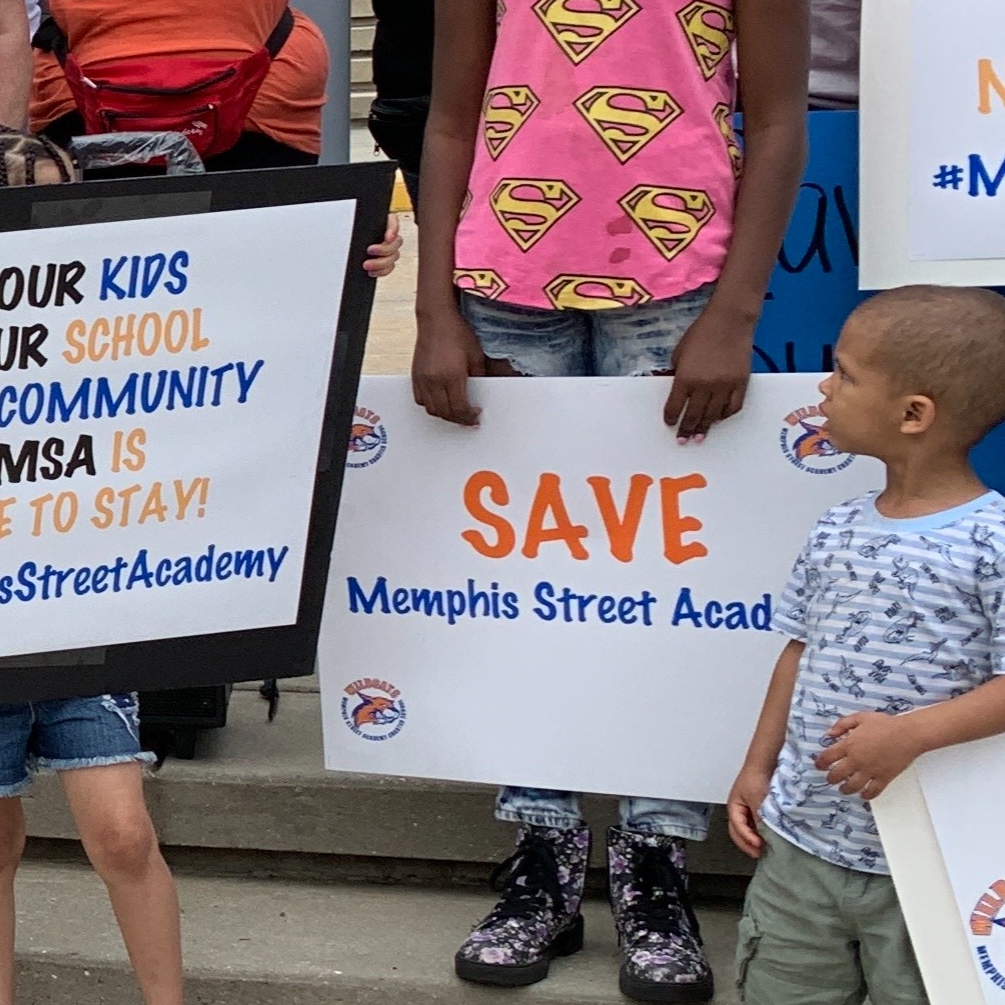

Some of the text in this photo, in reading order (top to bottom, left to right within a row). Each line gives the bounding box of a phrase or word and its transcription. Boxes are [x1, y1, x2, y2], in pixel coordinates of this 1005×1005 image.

[100, 250, 190, 300] KIDS
[62, 308, 209, 364] SCHOOL
[111, 428, 147, 473] IS
[31, 491, 78, 536] TO
[91, 477, 209, 531] STAY!
[462, 470, 707, 565] SAVE
[348, 578, 773, 631] Memphis Street Acad
